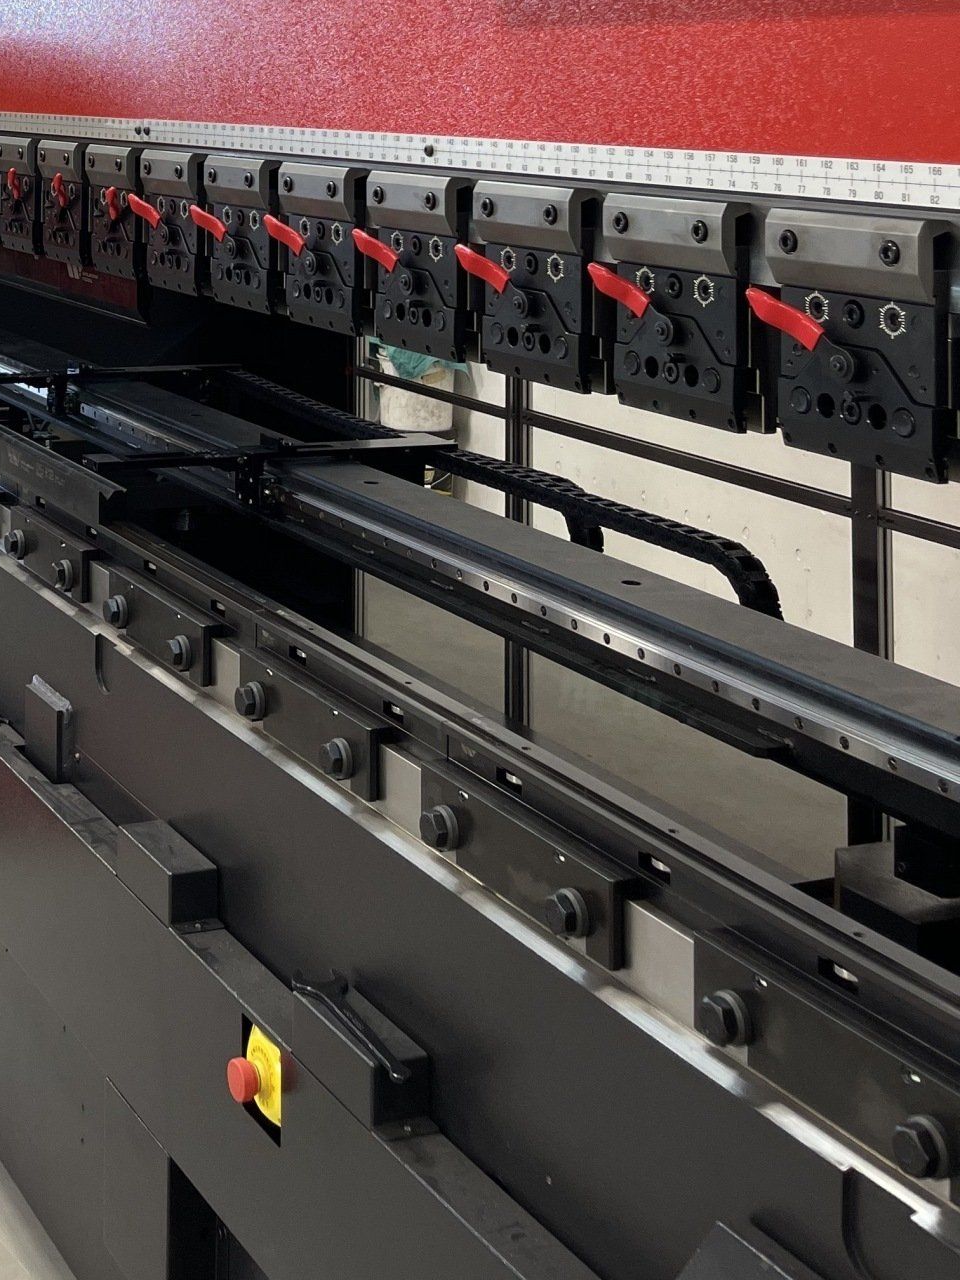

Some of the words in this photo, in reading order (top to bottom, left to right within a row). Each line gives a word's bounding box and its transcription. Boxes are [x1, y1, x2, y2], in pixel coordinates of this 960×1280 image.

[683, 152, 694, 160] 156
[704, 154, 715, 162] 157
[726, 155, 738, 163] 158
[748, 156, 760, 164] 159
[771, 157, 784, 166] 160
[795, 159, 807, 167] 161
[820, 160, 833, 169] 162
[846, 162, 859, 171] 163
[872, 163, 885, 172] 164
[900, 165, 913, 174] 165
[928, 167, 942, 176] 166
[773, 183, 782, 192] 76
[797, 185, 806, 194] 77
[822, 187, 832, 196] 78
[848, 189, 857, 198] 79
[873, 191, 884, 200] 80
[900, 193, 911, 202] 81
[929, 195, 941, 205] 82
